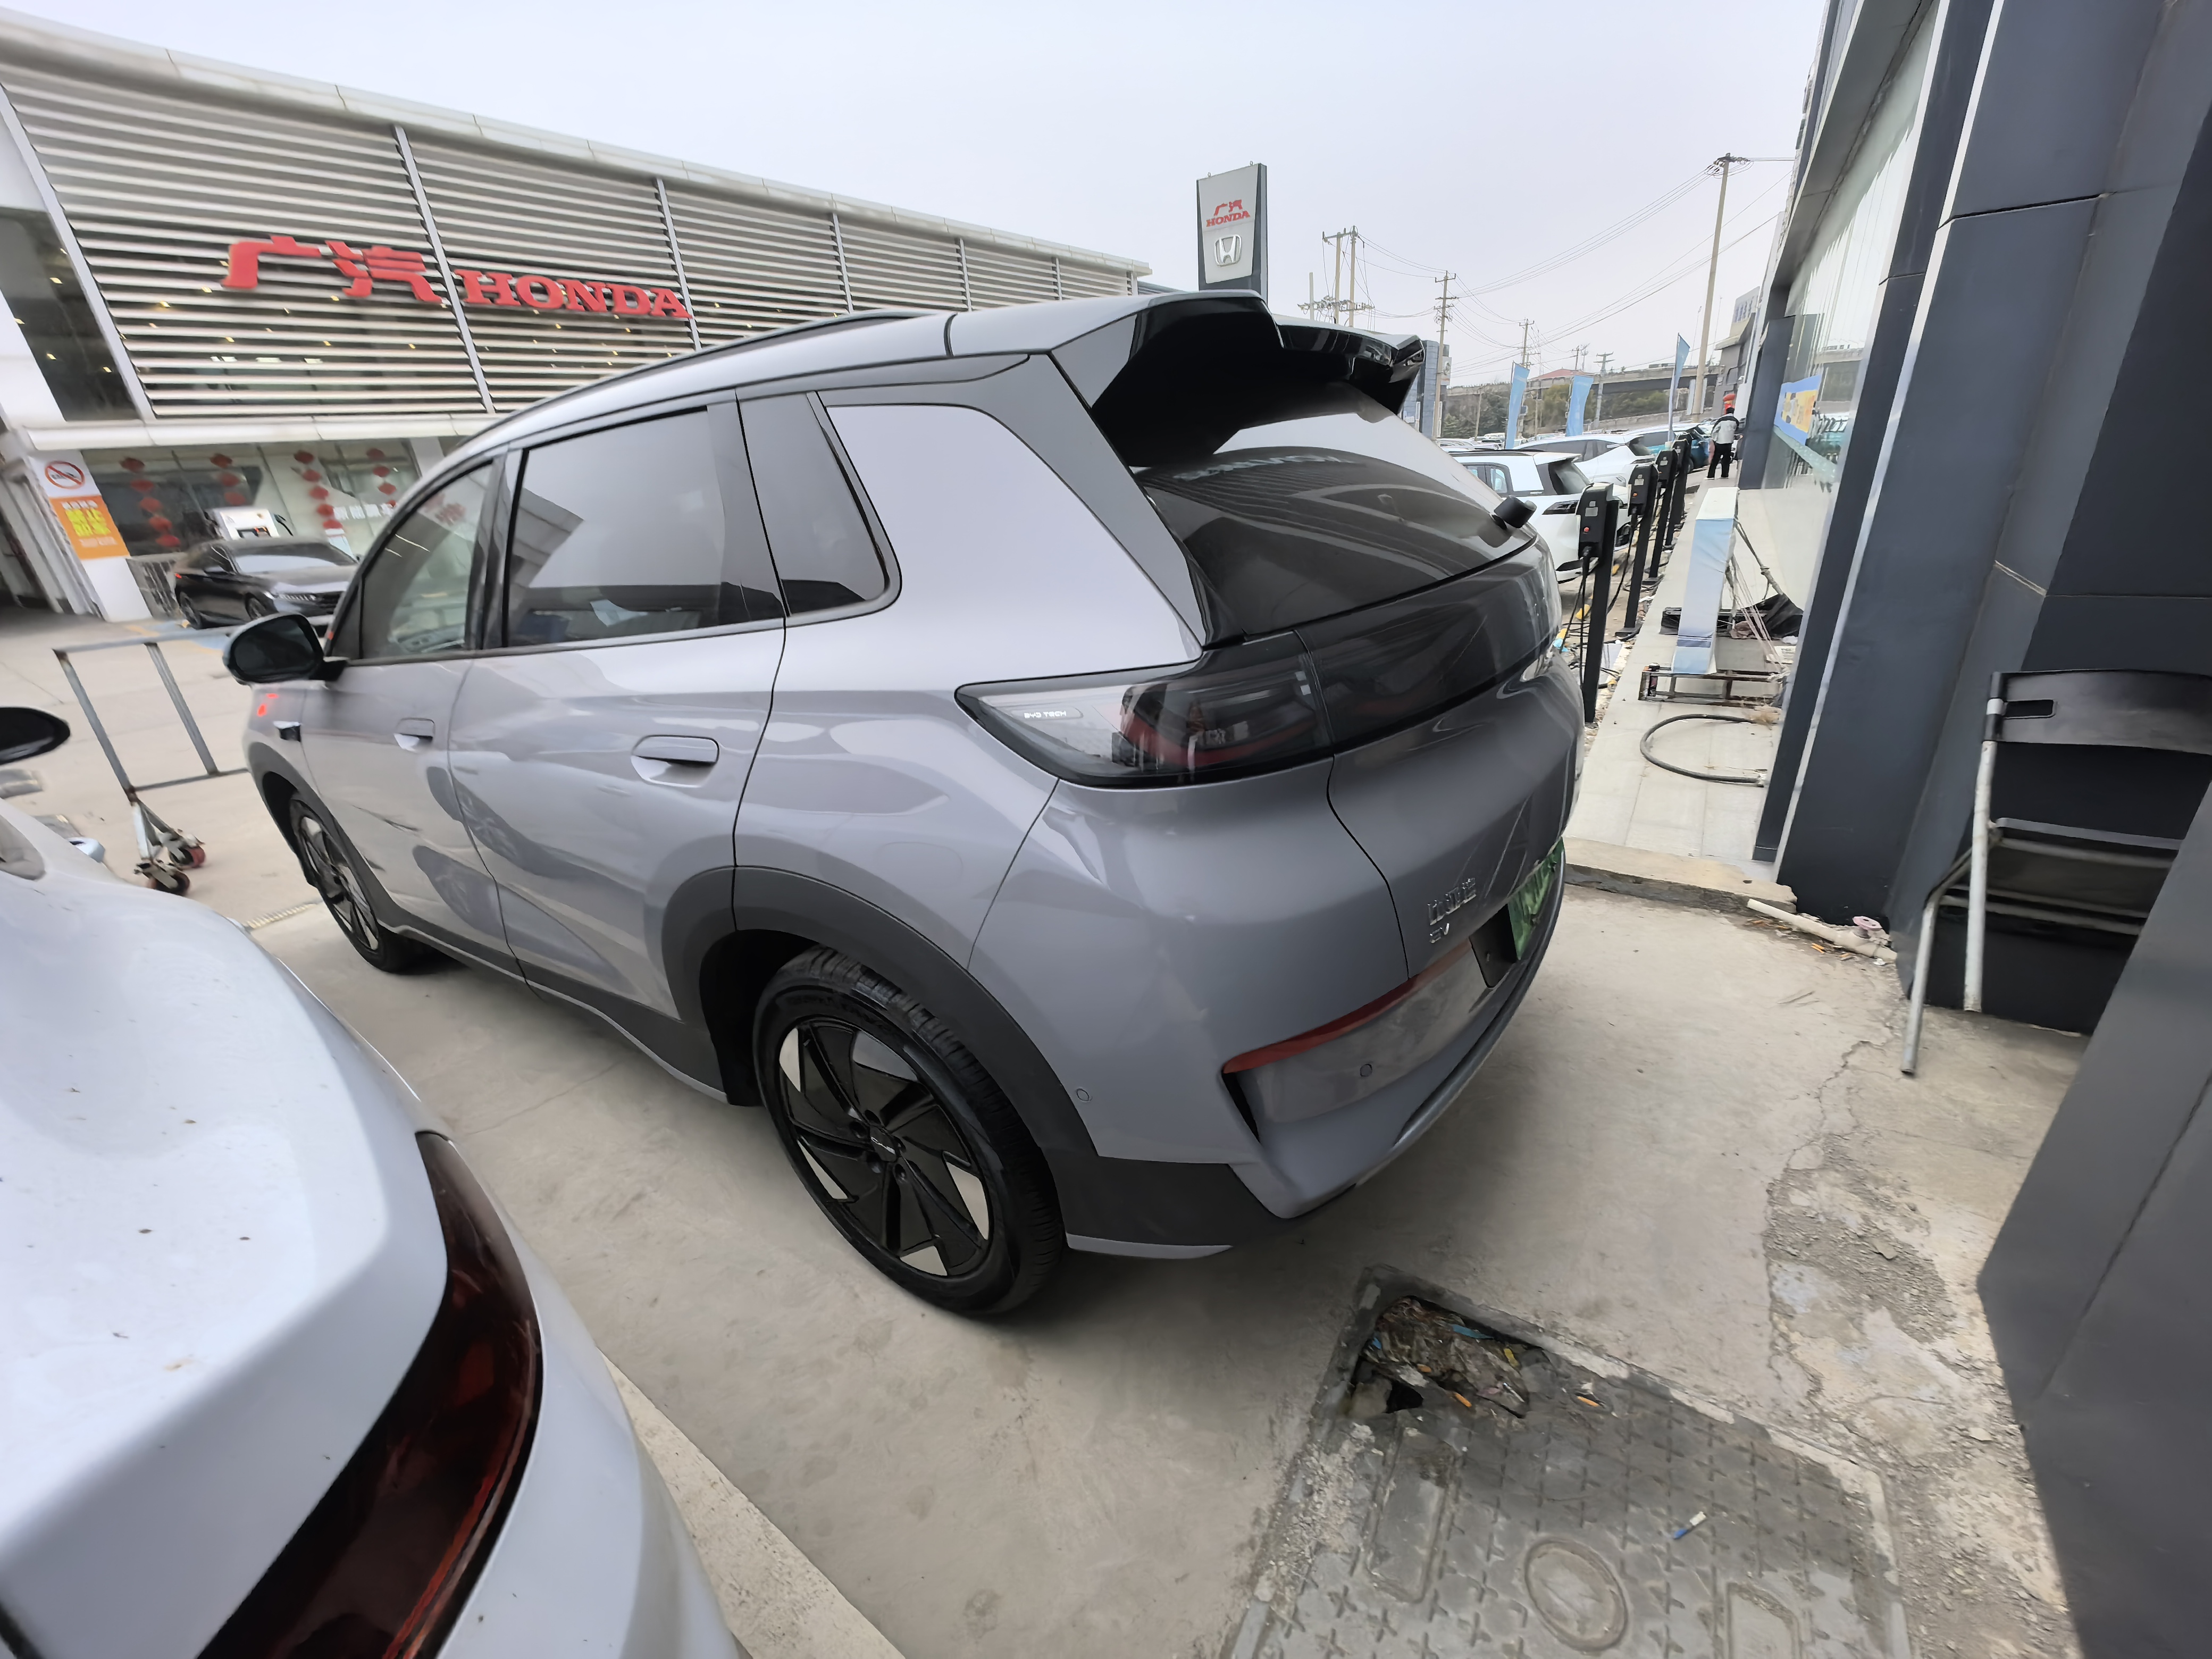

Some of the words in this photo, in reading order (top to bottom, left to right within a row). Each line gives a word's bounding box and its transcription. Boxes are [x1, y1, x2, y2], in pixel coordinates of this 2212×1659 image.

[1213, 199, 1243, 216] 广汽
[1206, 211, 1250, 227] HONDA
[222, 235, 442, 303] 广汽
[455, 269, 693, 319] HONDA
